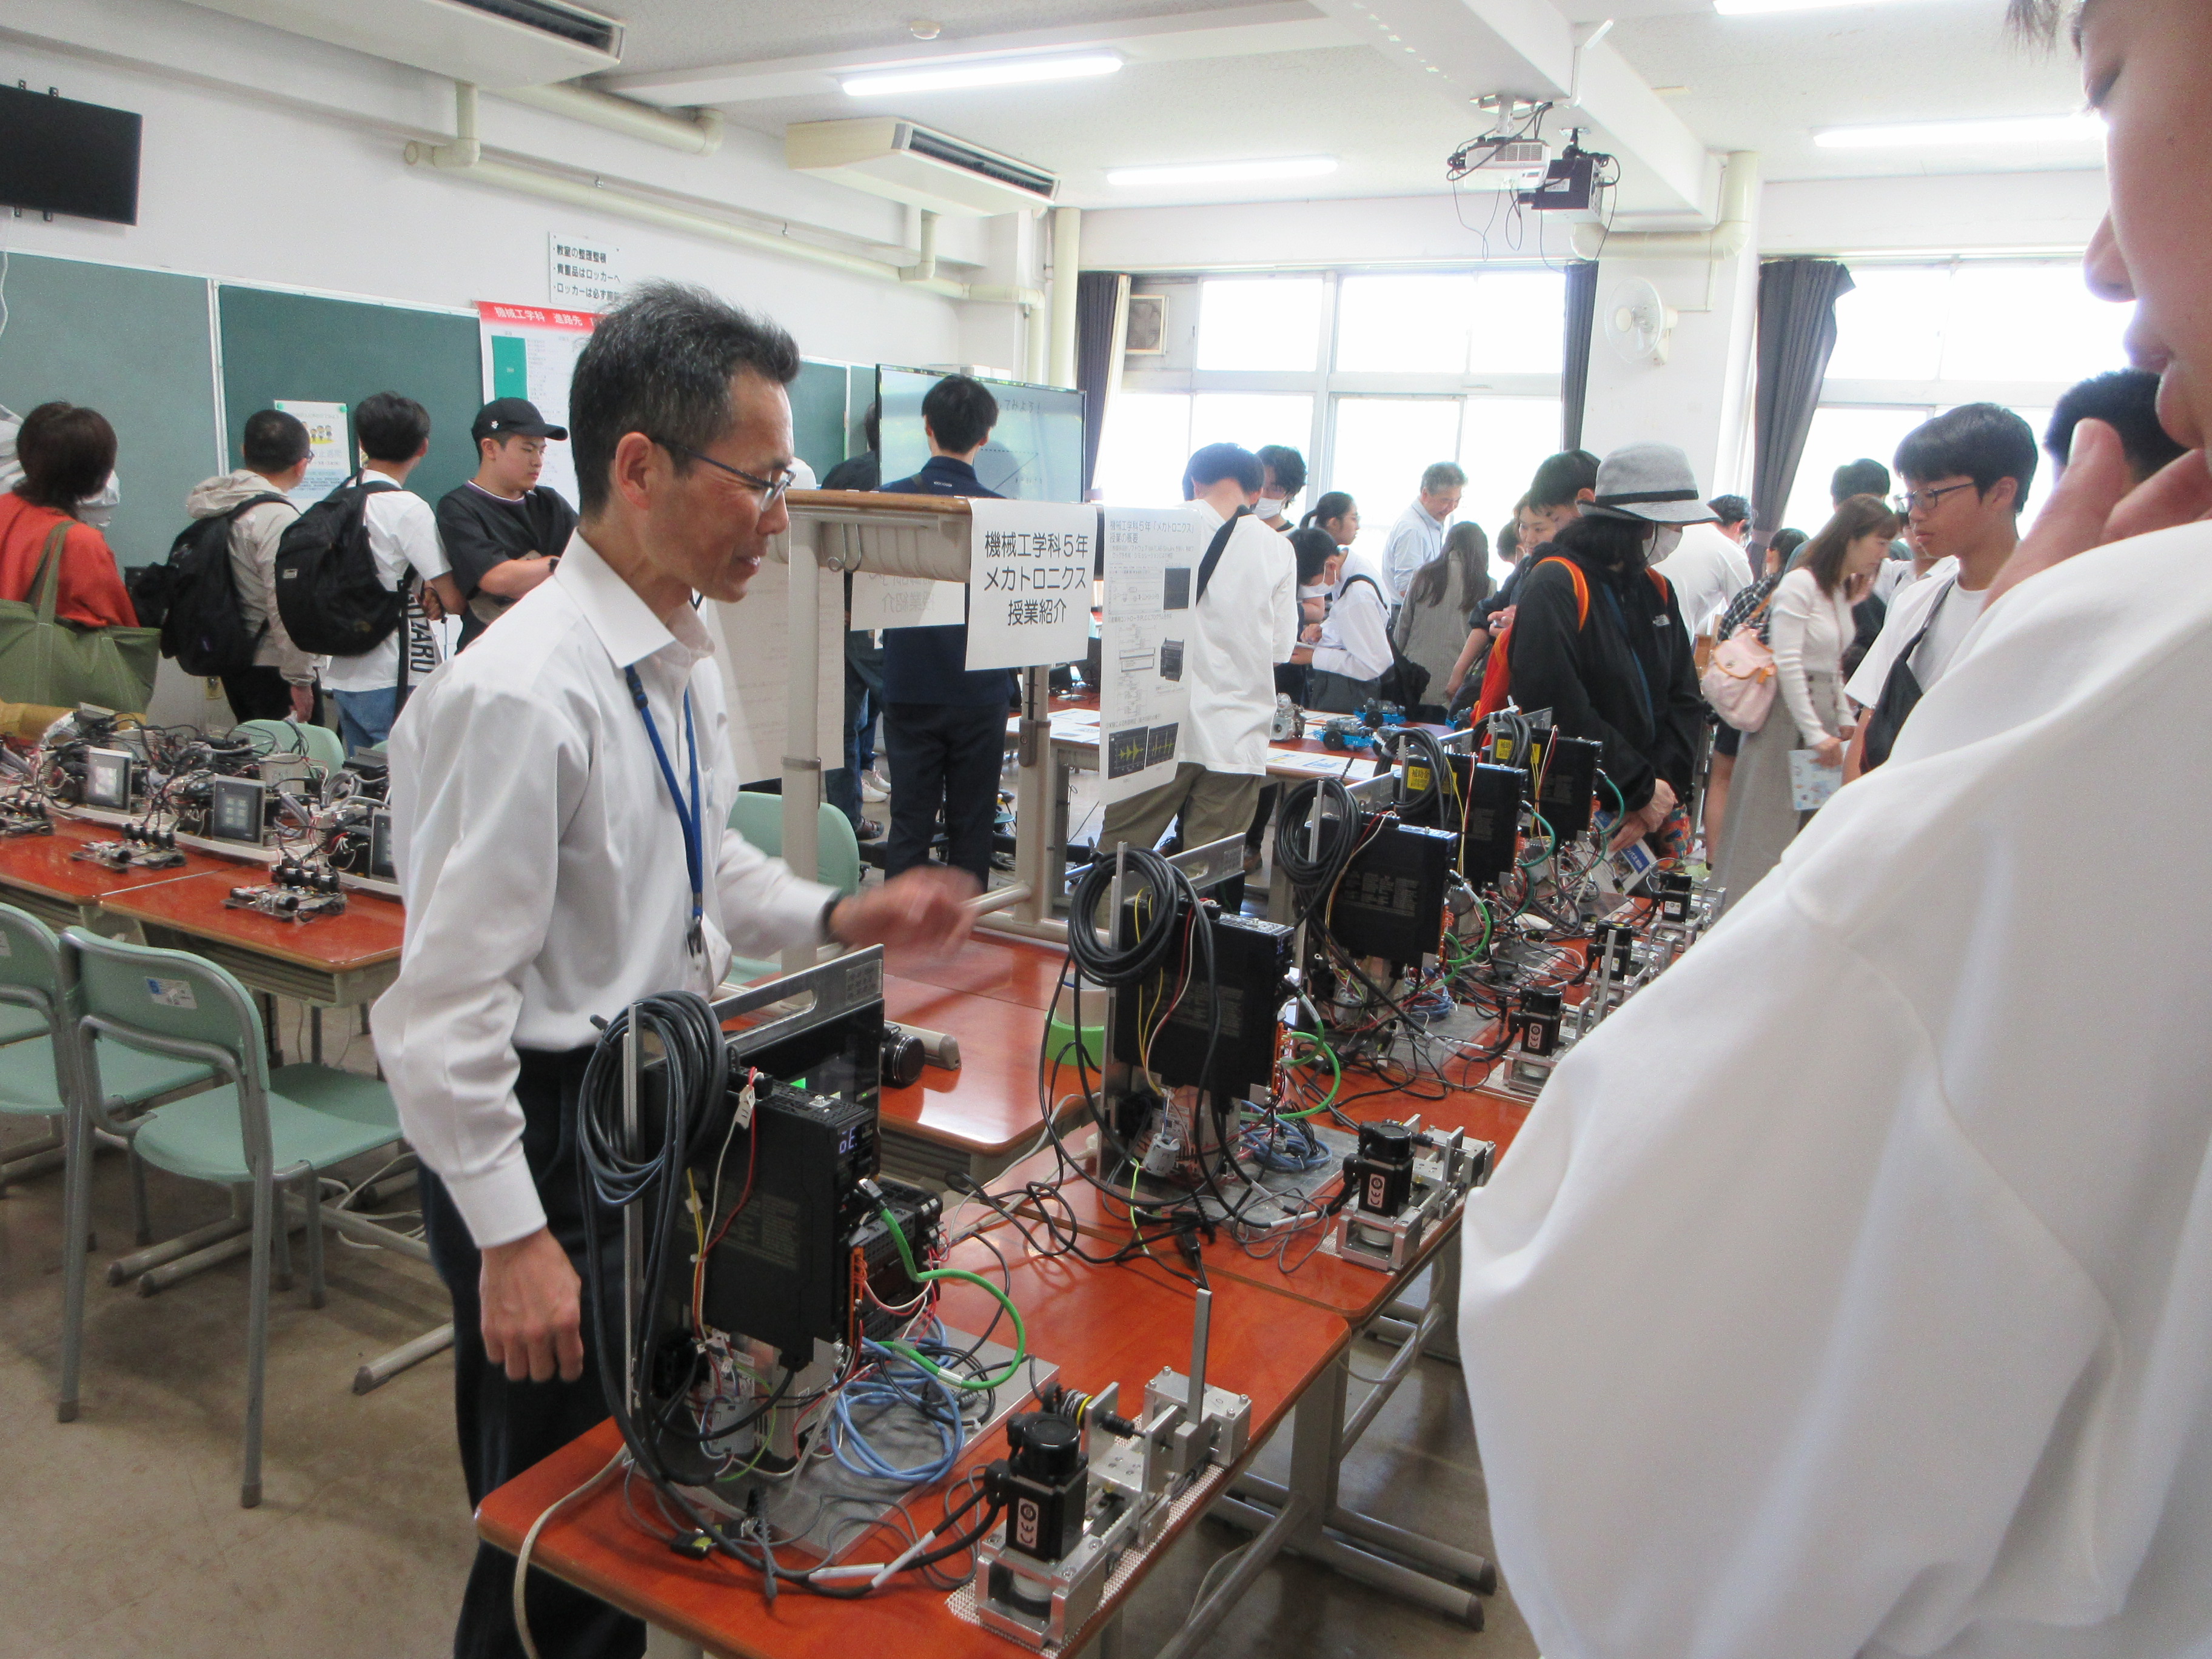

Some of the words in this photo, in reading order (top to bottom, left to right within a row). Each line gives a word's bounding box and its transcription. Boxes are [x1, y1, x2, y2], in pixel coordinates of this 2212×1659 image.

[494, 306, 545, 322] 機械工学科
[554, 313, 583, 326] 進路先
[985, 531, 1088, 558] 機械工学科5年
[984, 566, 1086, 592] メカトロニクス
[1008, 598, 1067, 626] 授業紹介
[1020, 1521, 1034, 1544] CE
